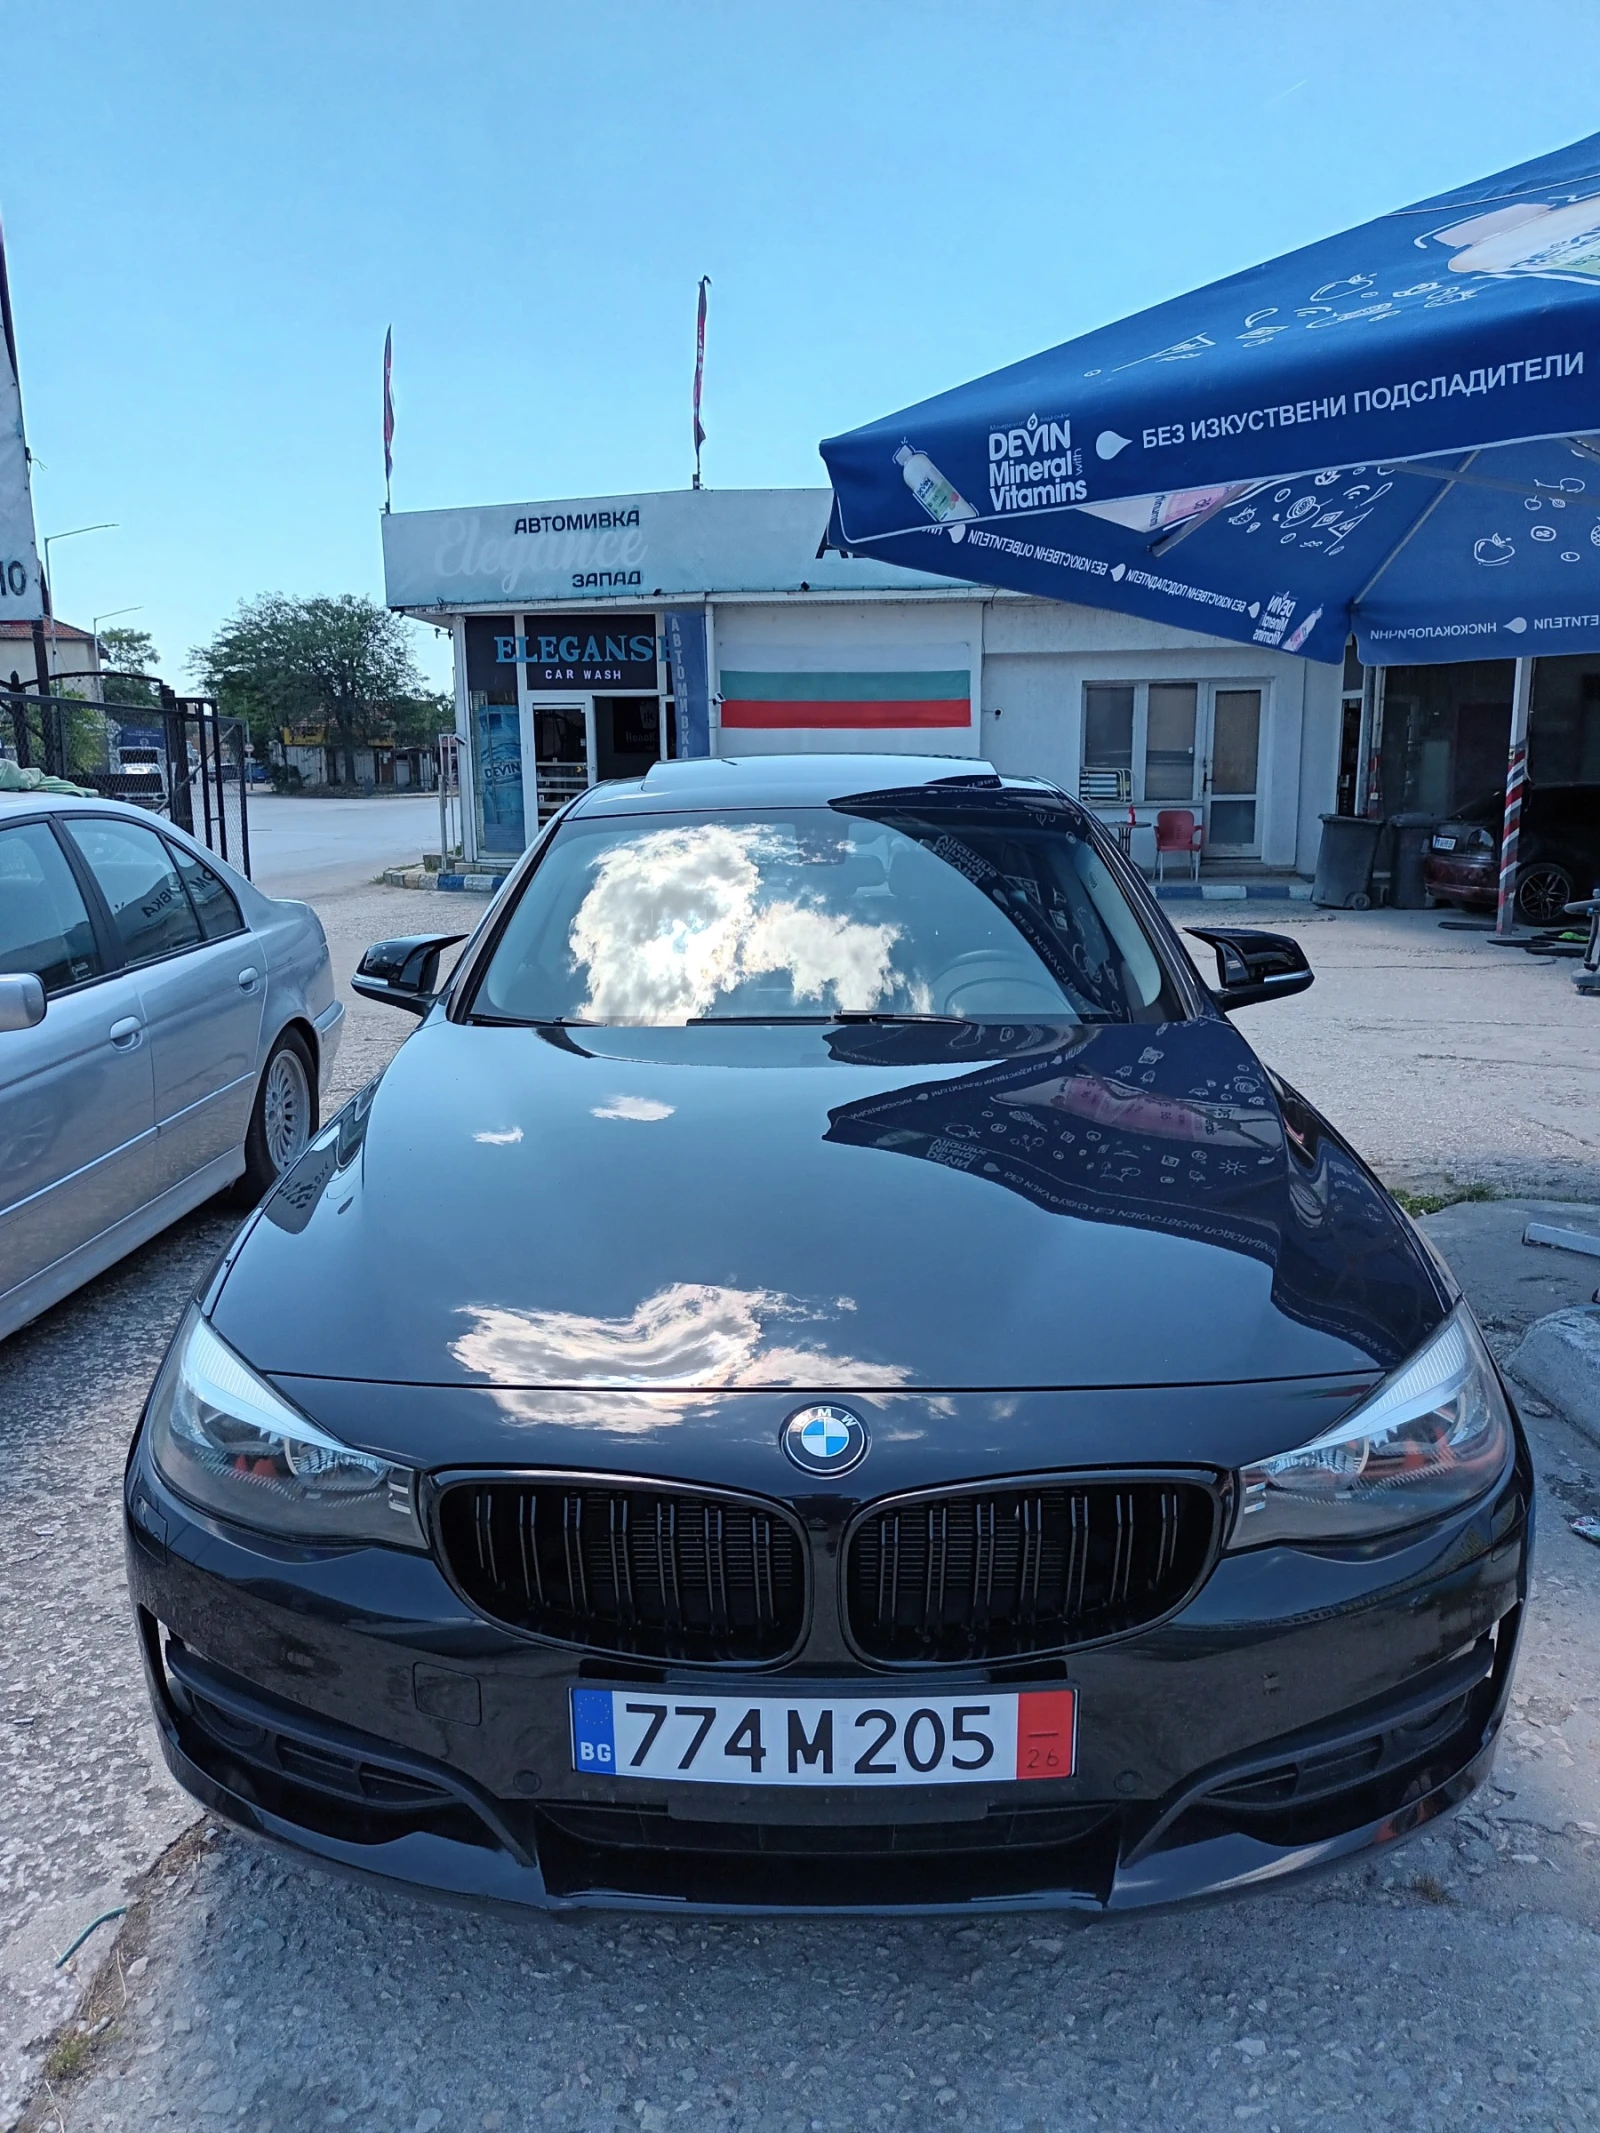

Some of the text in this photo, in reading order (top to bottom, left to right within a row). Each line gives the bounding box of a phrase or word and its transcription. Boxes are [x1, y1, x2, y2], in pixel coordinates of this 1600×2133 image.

[1142, 352, 1584, 449] БЕЗ ИЗКУСТВЕНИ ПОДСЛАДИТЕЛИ
[989, 419, 1071, 461] DEVIN
[989, 448, 1082, 487] Mineral with
[989, 478, 1087, 512] Vitamins
[514, 509, 641, 535] АВТОМИВКА
[572, 570, 642, 588] ЗАПАД
[545, 669, 622, 680] CAR WASH
[484, 762, 521, 779] DEVIN
[580, 1742, 612, 1762] BG
[1027, 1748, 1058, 1769] 26
